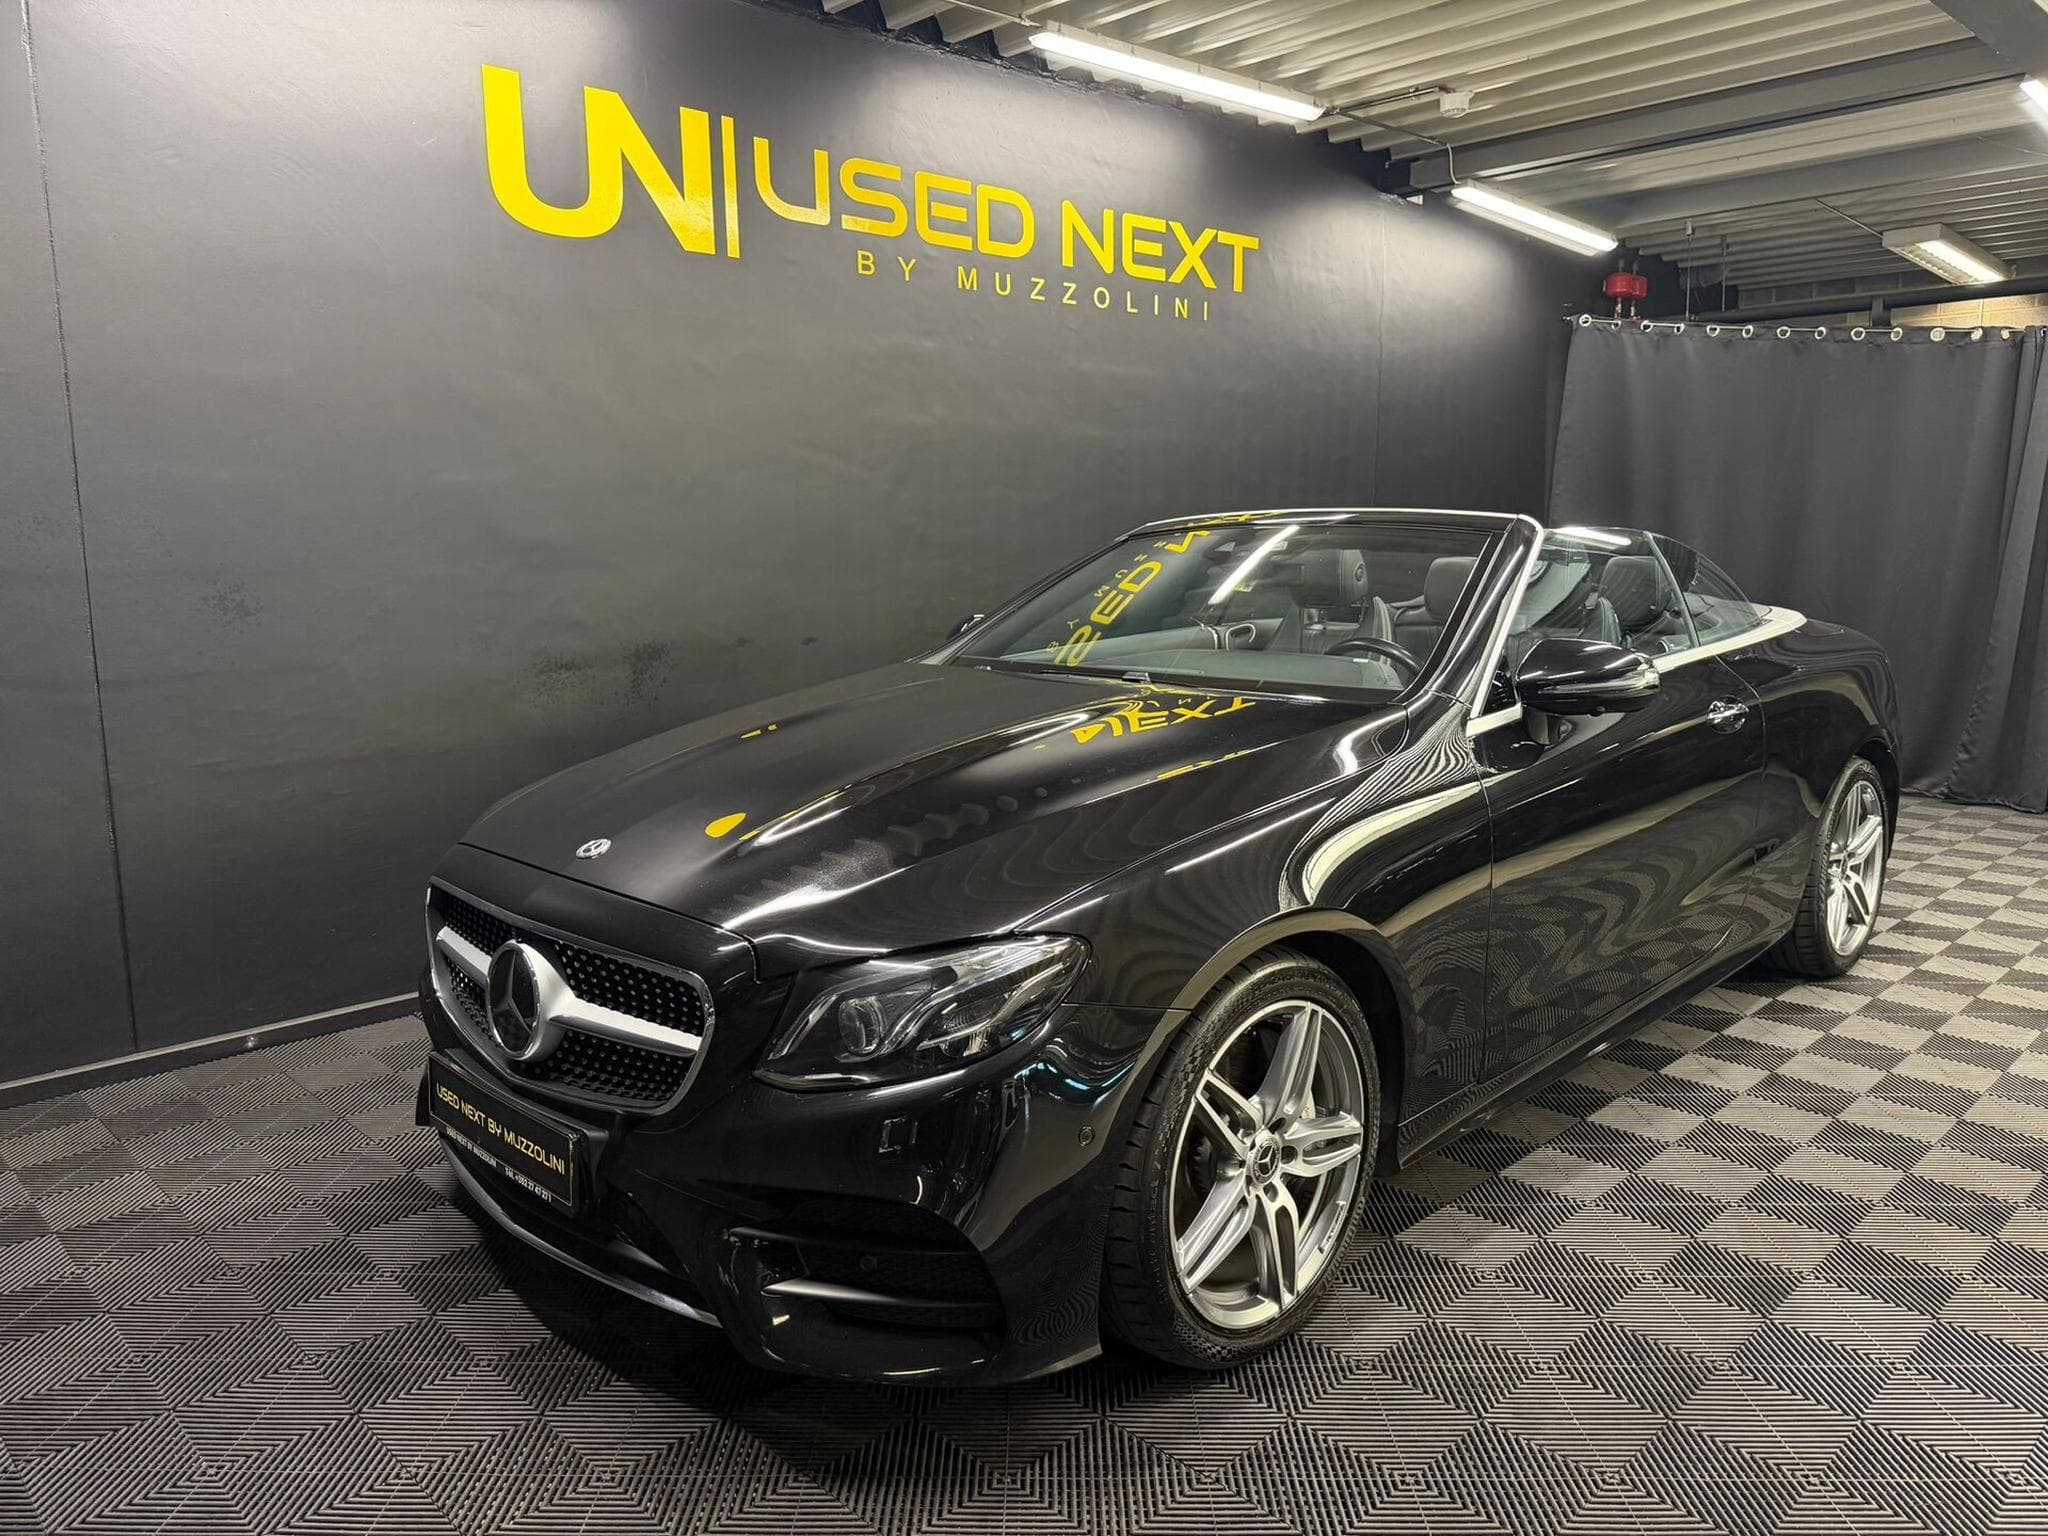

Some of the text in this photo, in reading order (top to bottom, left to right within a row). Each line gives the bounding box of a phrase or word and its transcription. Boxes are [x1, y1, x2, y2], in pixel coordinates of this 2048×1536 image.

[752, 135, 1261, 294] USED NEXT
[856, 249, 1211, 321] BY MUZZOLINI
[436, 1082, 565, 1176] USED NEXT BY MUZZOLINI
